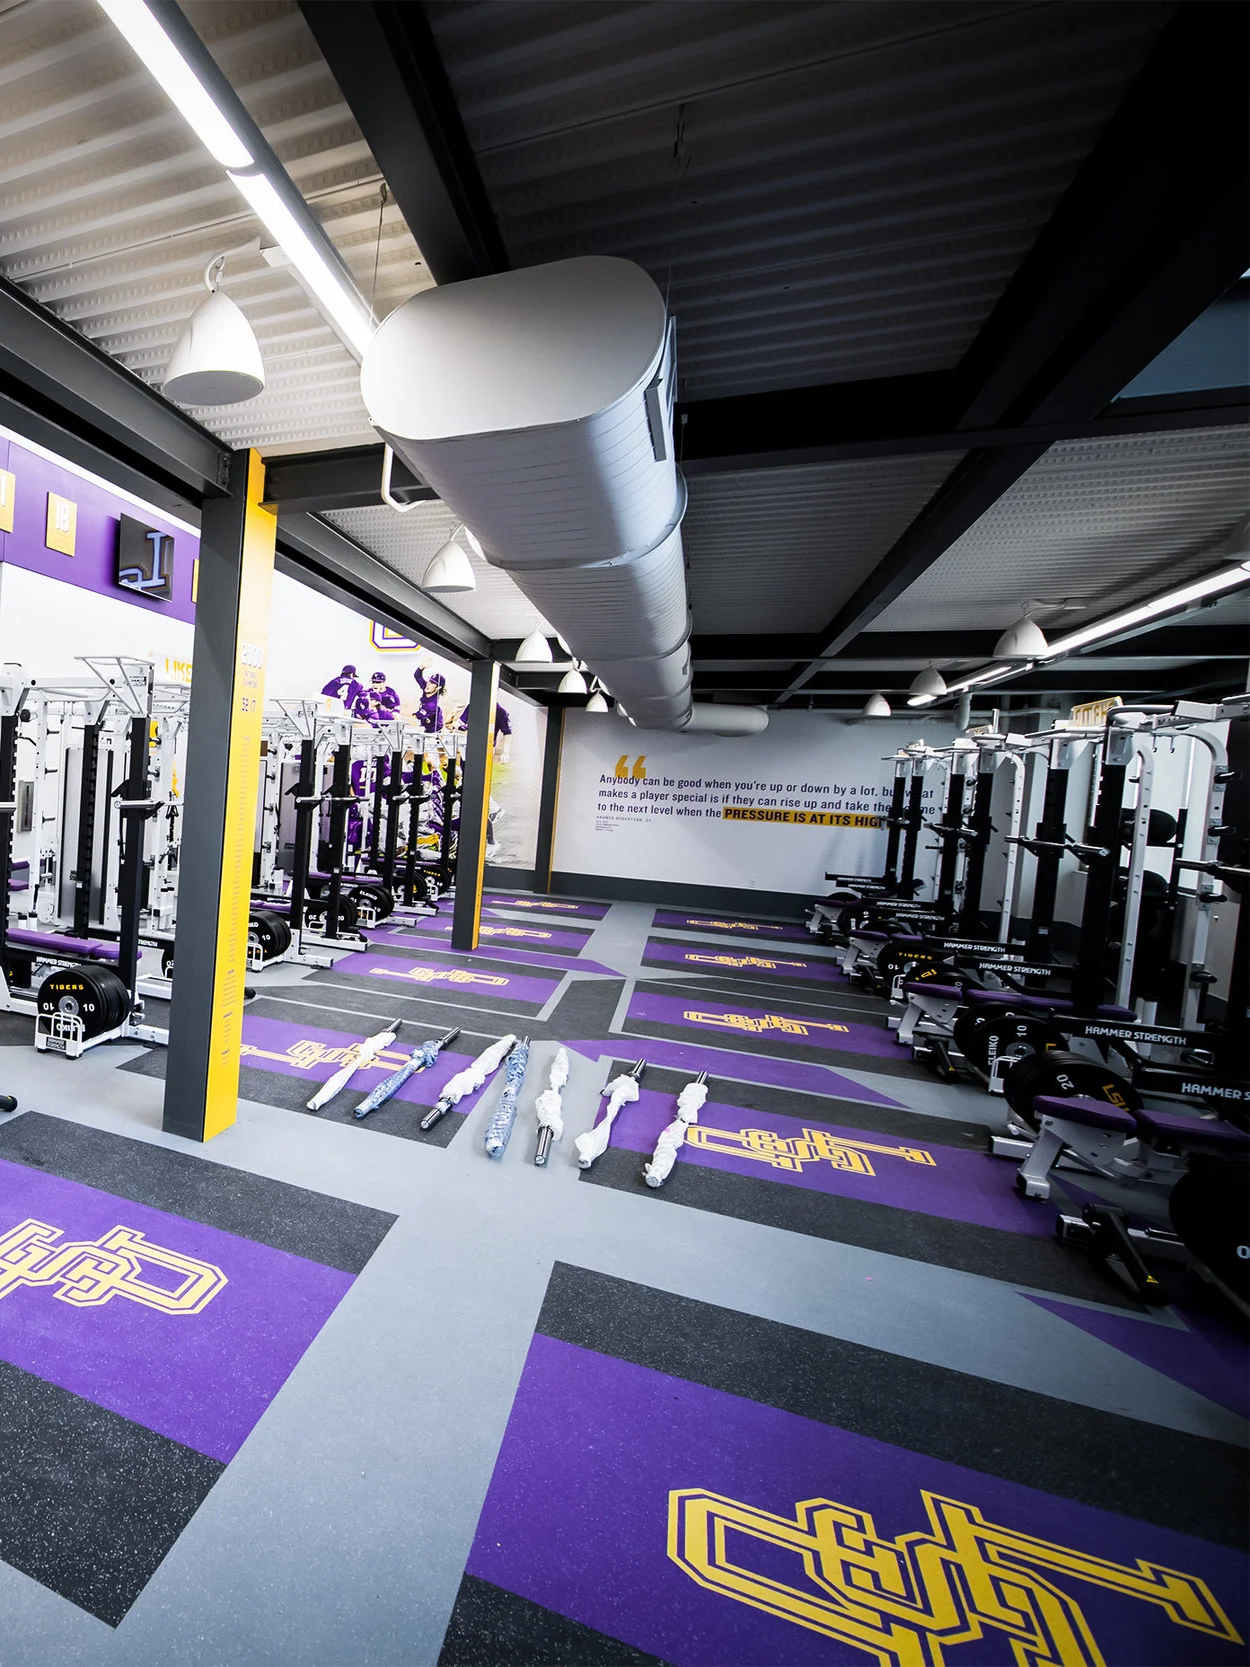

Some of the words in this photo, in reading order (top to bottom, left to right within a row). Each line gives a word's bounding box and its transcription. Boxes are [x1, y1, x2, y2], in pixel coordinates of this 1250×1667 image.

[56, 500, 70, 533] 18
[337, 684, 350, 701] 4
[600, 775, 639, 787] Anybody
[643, 778, 660, 786] can
[663, 777, 675, 787] be
[677, 778, 701, 789] good
[705, 780, 731, 789] when
[734, 781, 767, 792] you're
[770, 783, 782, 793] up
[786, 784, 797, 792] or
[801, 783, 829, 794] down
[834, 784, 846, 796] by
[850, 787, 856, 795] a
[860, 785, 878, 796] lot,
[882, 786, 894, 797] bu
[905, 790, 934, 799] wat
[599, 789, 628, 798] makes
[640, 790, 669, 801] player
[672, 792, 707, 804] special
[710, 793, 719, 803] is
[722, 793, 729, 804] if
[732, 794, 754, 807] they
[758, 798, 777, 806] can
[780, 798, 800, 807] rise
[804, 800, 817, 811] up
[821, 799, 841, 810] and
[845, 800, 869, 812] take
[874, 801, 890, 812] the
[598, 803, 606, 811] to
[610, 803, 624, 812] the
[627, 804, 647, 814] next
[651, 804, 673, 815] level
[676, 807, 702, 817] when
[705, 808, 721, 818] the
[725, 808, 790, 822] PRESSURE
[794, 812, 806, 822] IS
[809, 813, 825, 824] AT
[830, 815, 850, 825] ITS
[898, 952, 933, 960] TIGERS
[944, 942, 973, 950] HAMMER
[974, 944, 1005, 953] STRENGTH
[979, 962, 1012, 972] HAMMER
[1013, 966, 1051, 976] STRENGTH
[83, 1003, 95, 1012] 10
[1017, 1025, 1027, 1038] 10
[1085, 1025, 1132, 1039] HAMMER
[1134, 1031, 1187, 1045] STRENGTH
[1056, 1074, 1074, 1090] 20
[1182, 1082, 1242, 1100] HAMMER
